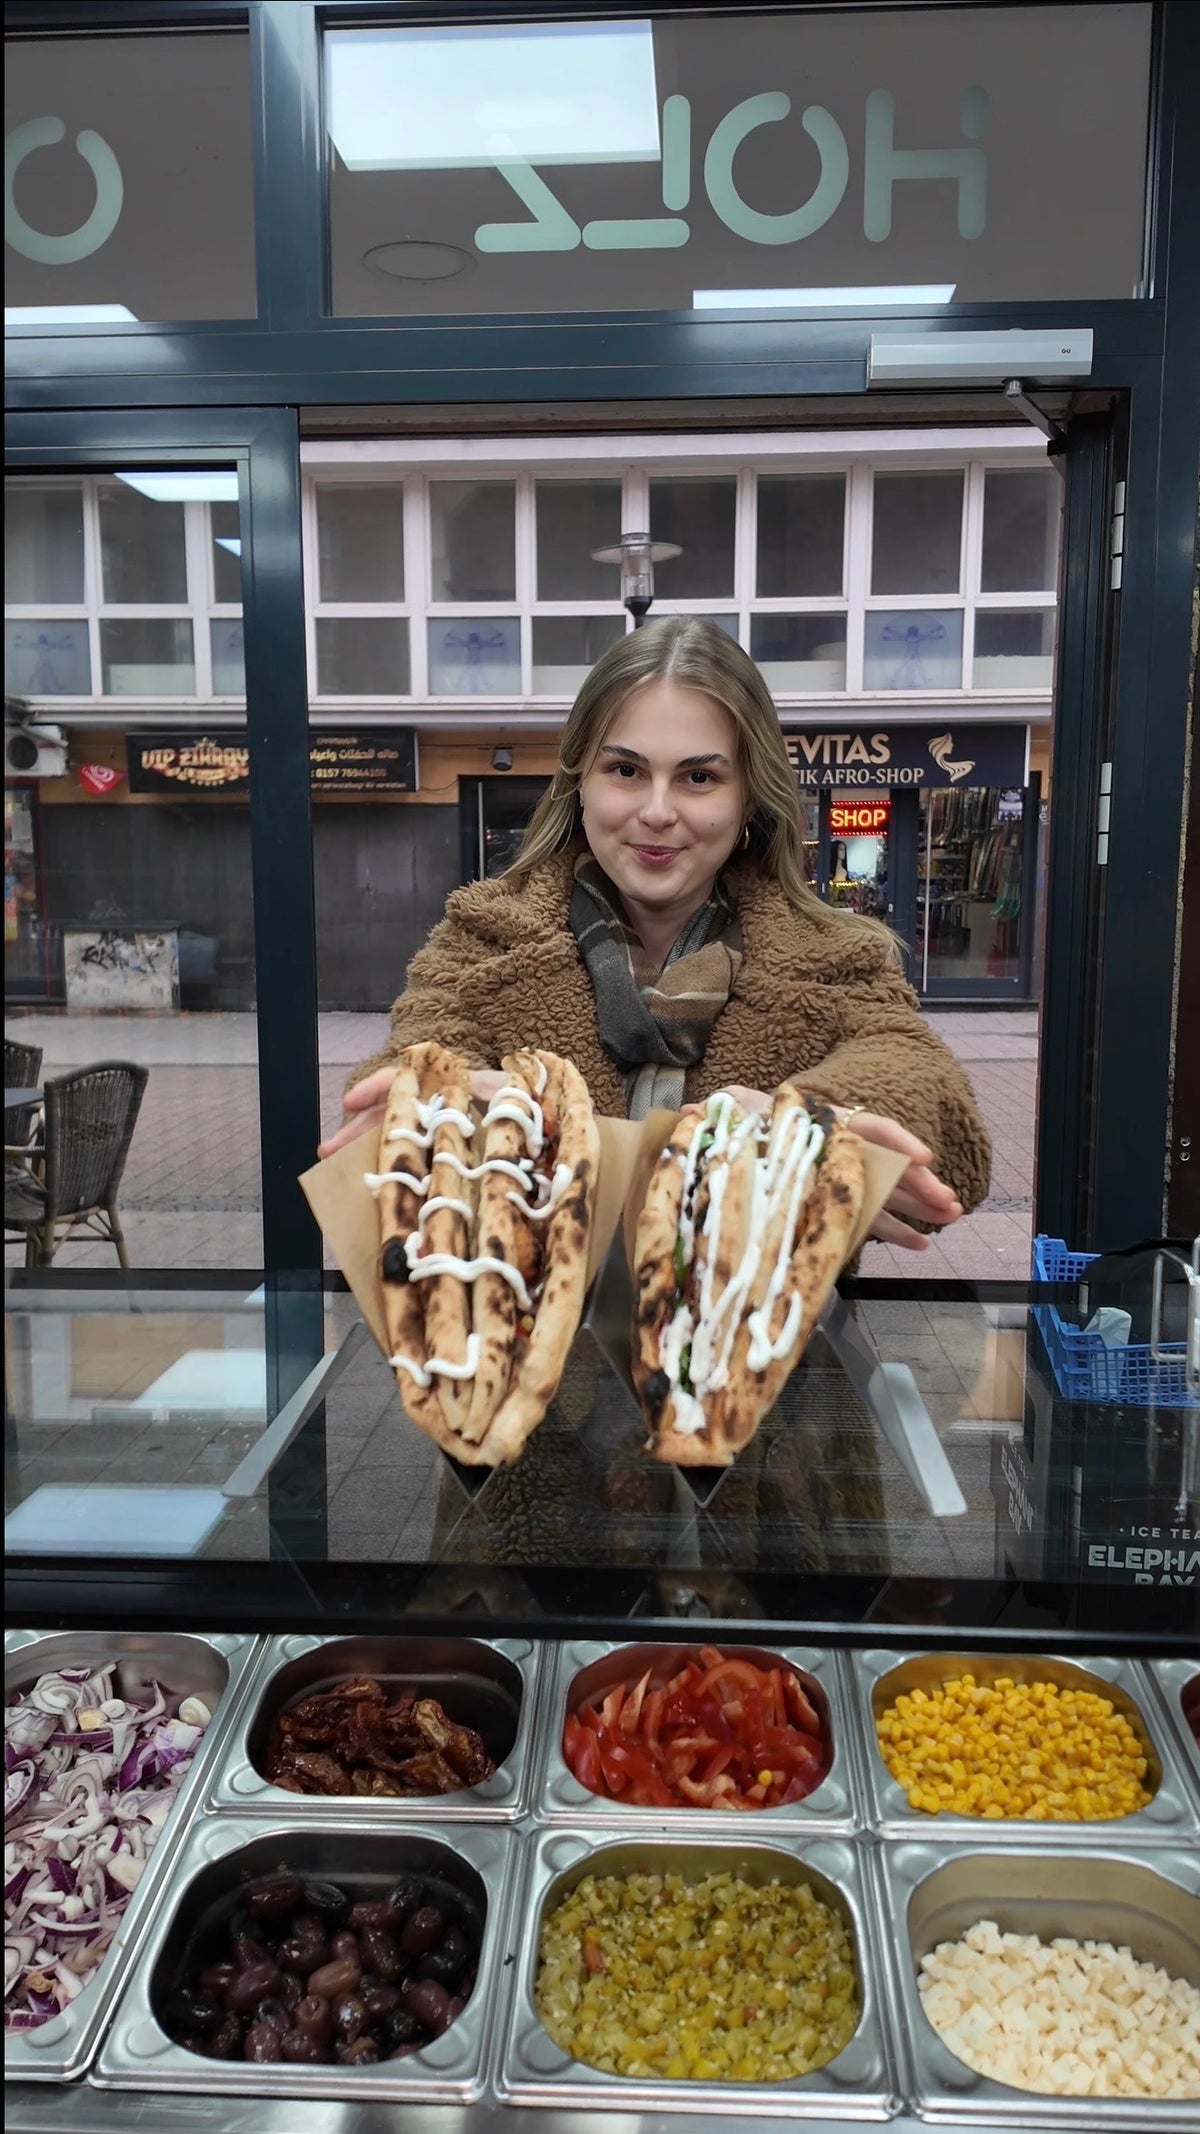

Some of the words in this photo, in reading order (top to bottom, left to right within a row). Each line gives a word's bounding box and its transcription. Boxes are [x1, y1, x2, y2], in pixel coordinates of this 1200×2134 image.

[783, 734, 889, 764] EVITAS
[822, 767, 924, 788] AFRO-SHOP
[831, 808, 887, 827] SHOP
[1130, 1526, 1161, 1538] ICE
